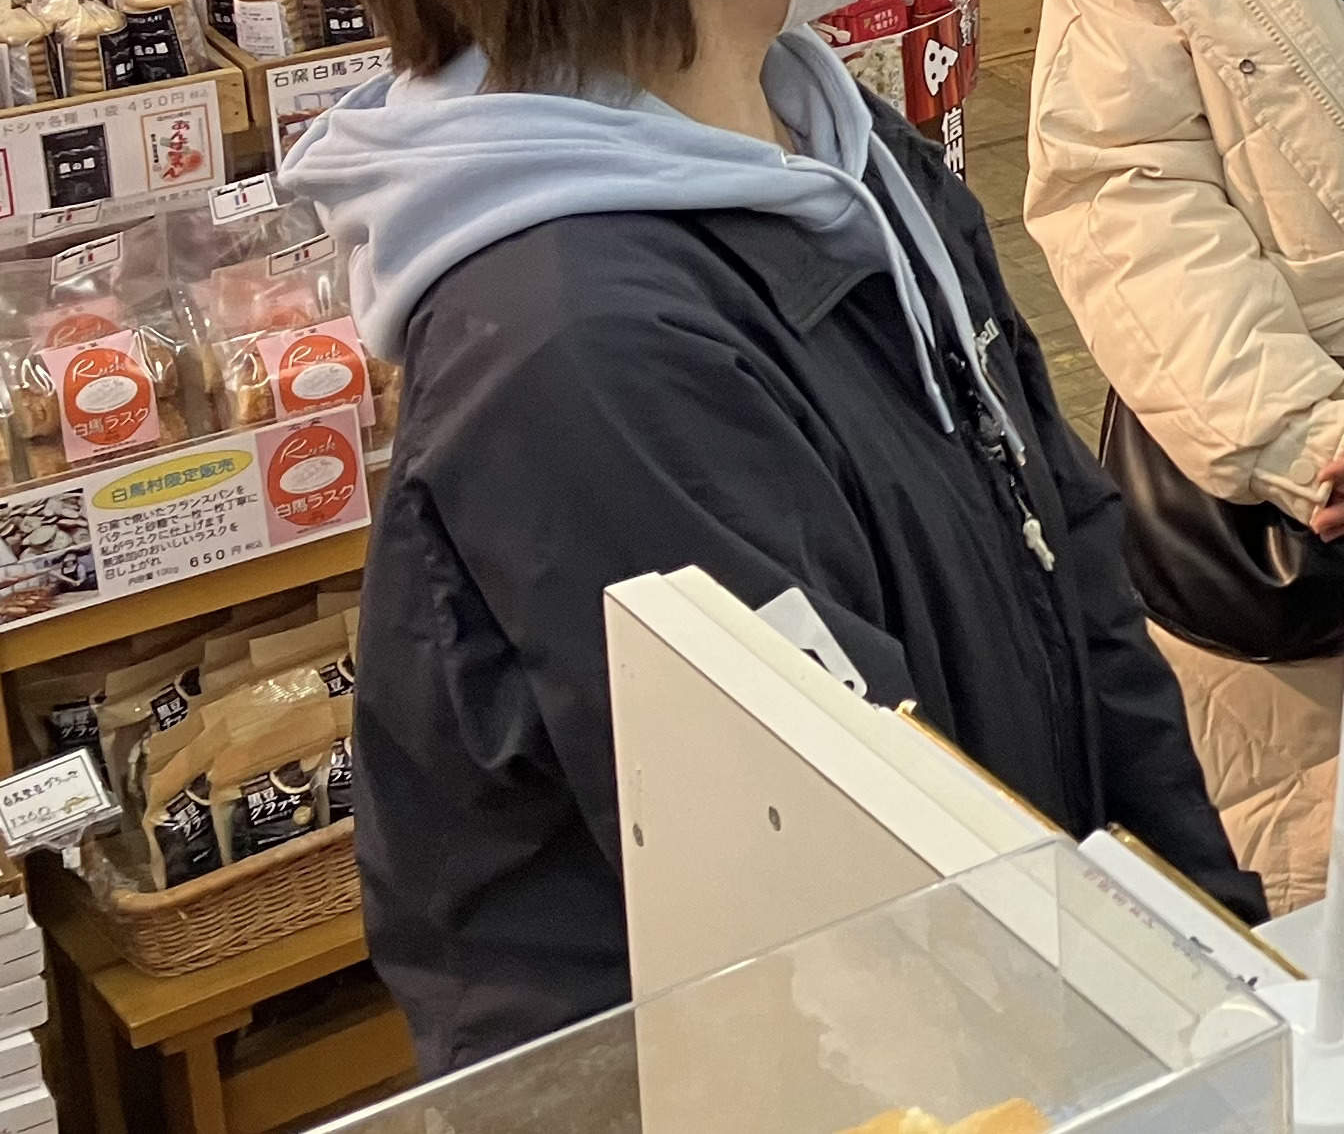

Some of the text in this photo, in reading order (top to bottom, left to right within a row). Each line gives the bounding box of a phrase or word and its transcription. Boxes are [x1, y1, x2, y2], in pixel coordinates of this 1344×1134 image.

[74, 407, 149, 437] 白馬ラスク
[279, 434, 336, 464] Rusk
[112, 457, 236, 504] 白馬村限定販売
[275, 484, 354, 518] 白馬ラスク
[189, 549, 226, 568] 650
[249, 787, 279, 806] 黒豆
[250, 793, 301, 821] グラッセ
